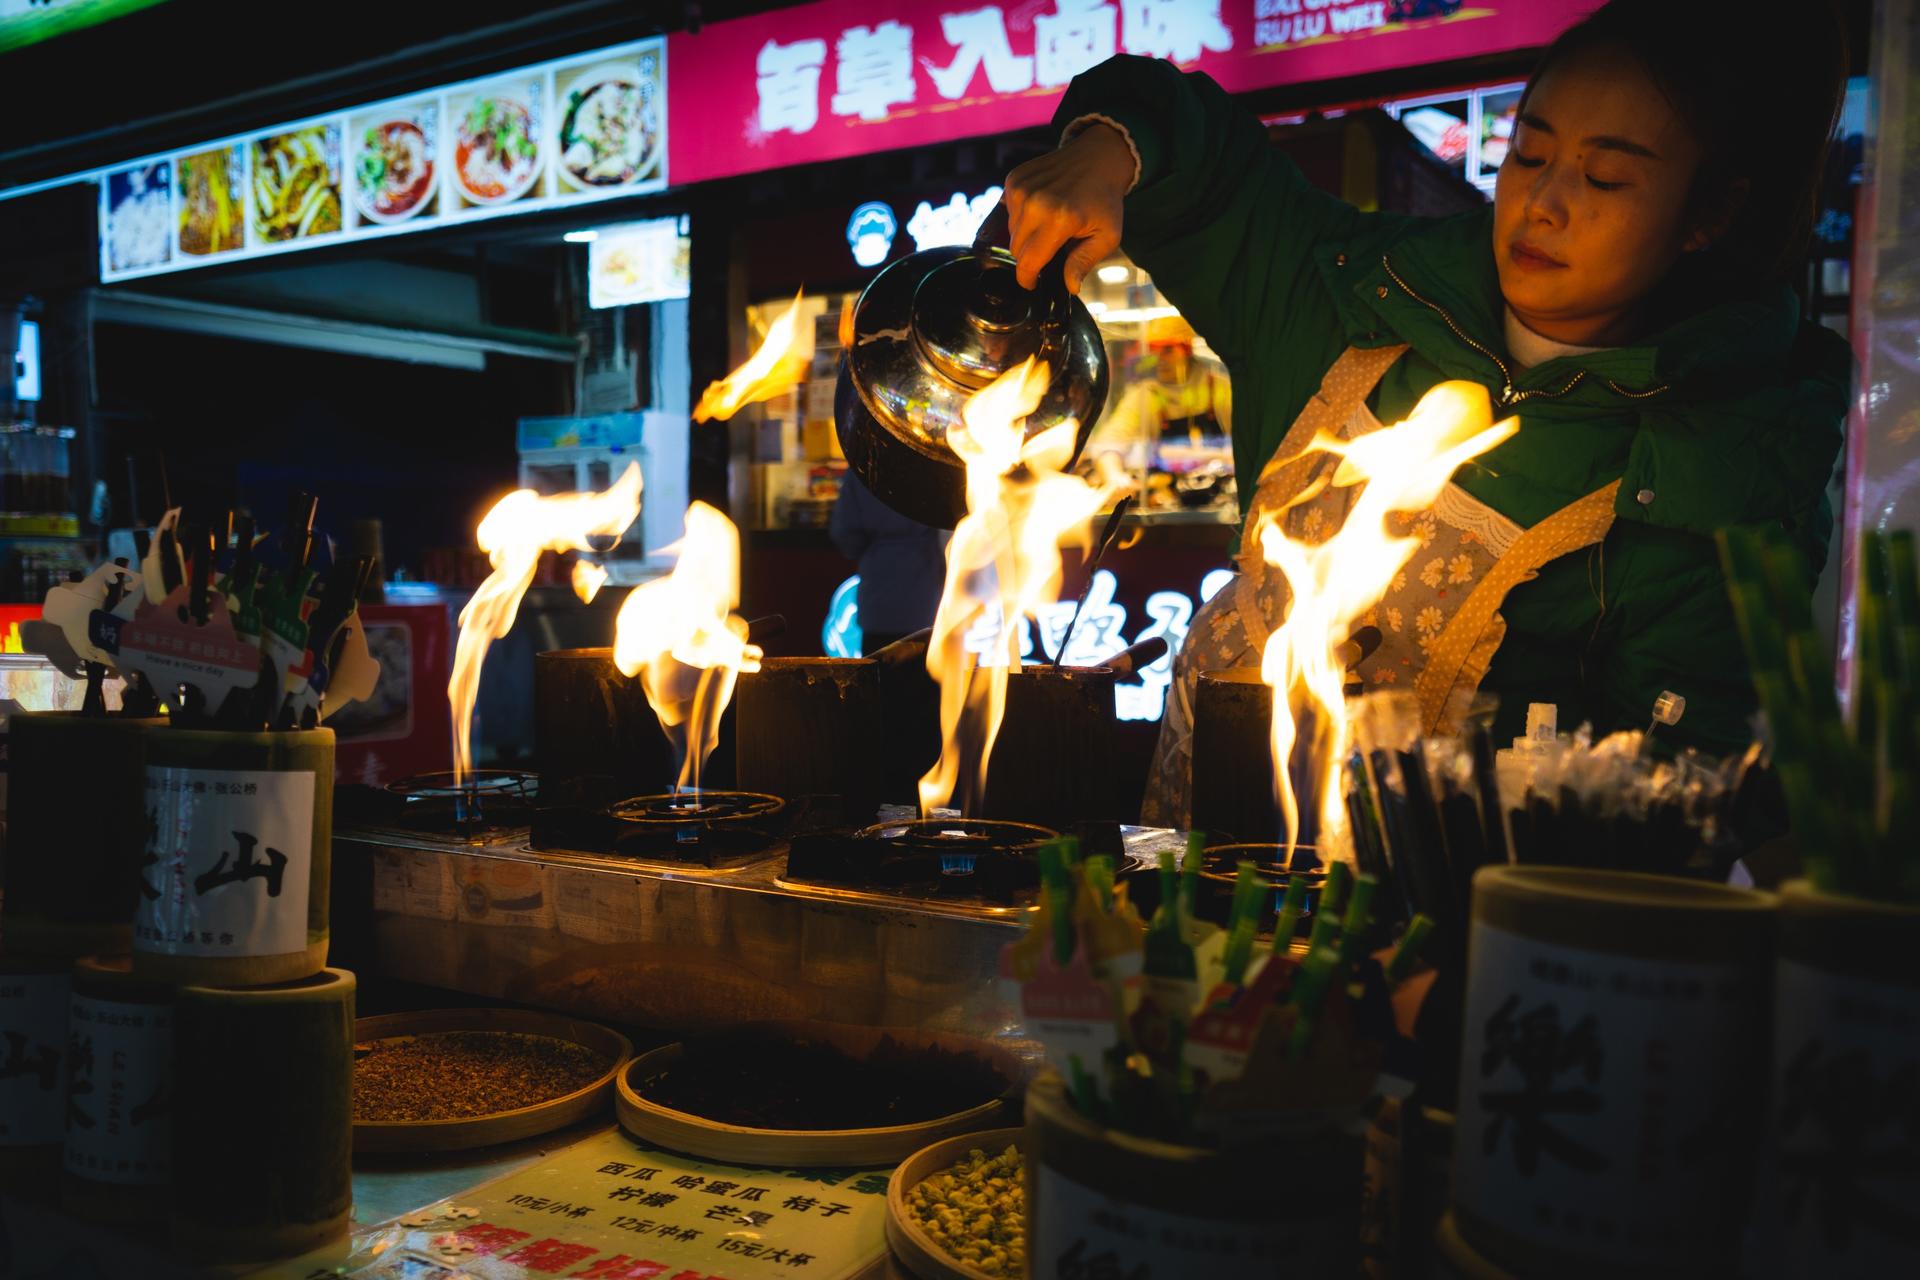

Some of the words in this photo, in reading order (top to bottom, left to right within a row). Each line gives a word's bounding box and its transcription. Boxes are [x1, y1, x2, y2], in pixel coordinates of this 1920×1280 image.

[1291, 13, 1325, 41] LU
[1330, 2, 1386, 33] WEI
[756, 0, 1233, 133] 百草入卤味
[183, 661, 202, 671] nice
[205, 664, 225, 678] day
[596, 1161, 662, 1181] 西瓜
[671, 1175, 770, 1202] 哈蜜瓜
[782, 1195, 852, 1217] 桔子
[608, 1186, 680, 1208] 柠檬
[704, 1205, 775, 1228] 芒果
[505, 1193, 596, 1219] 10元/小杯
[609, 1216, 704, 1242] 12元/中杯
[716, 1238, 816, 1267] 15元/大杯
